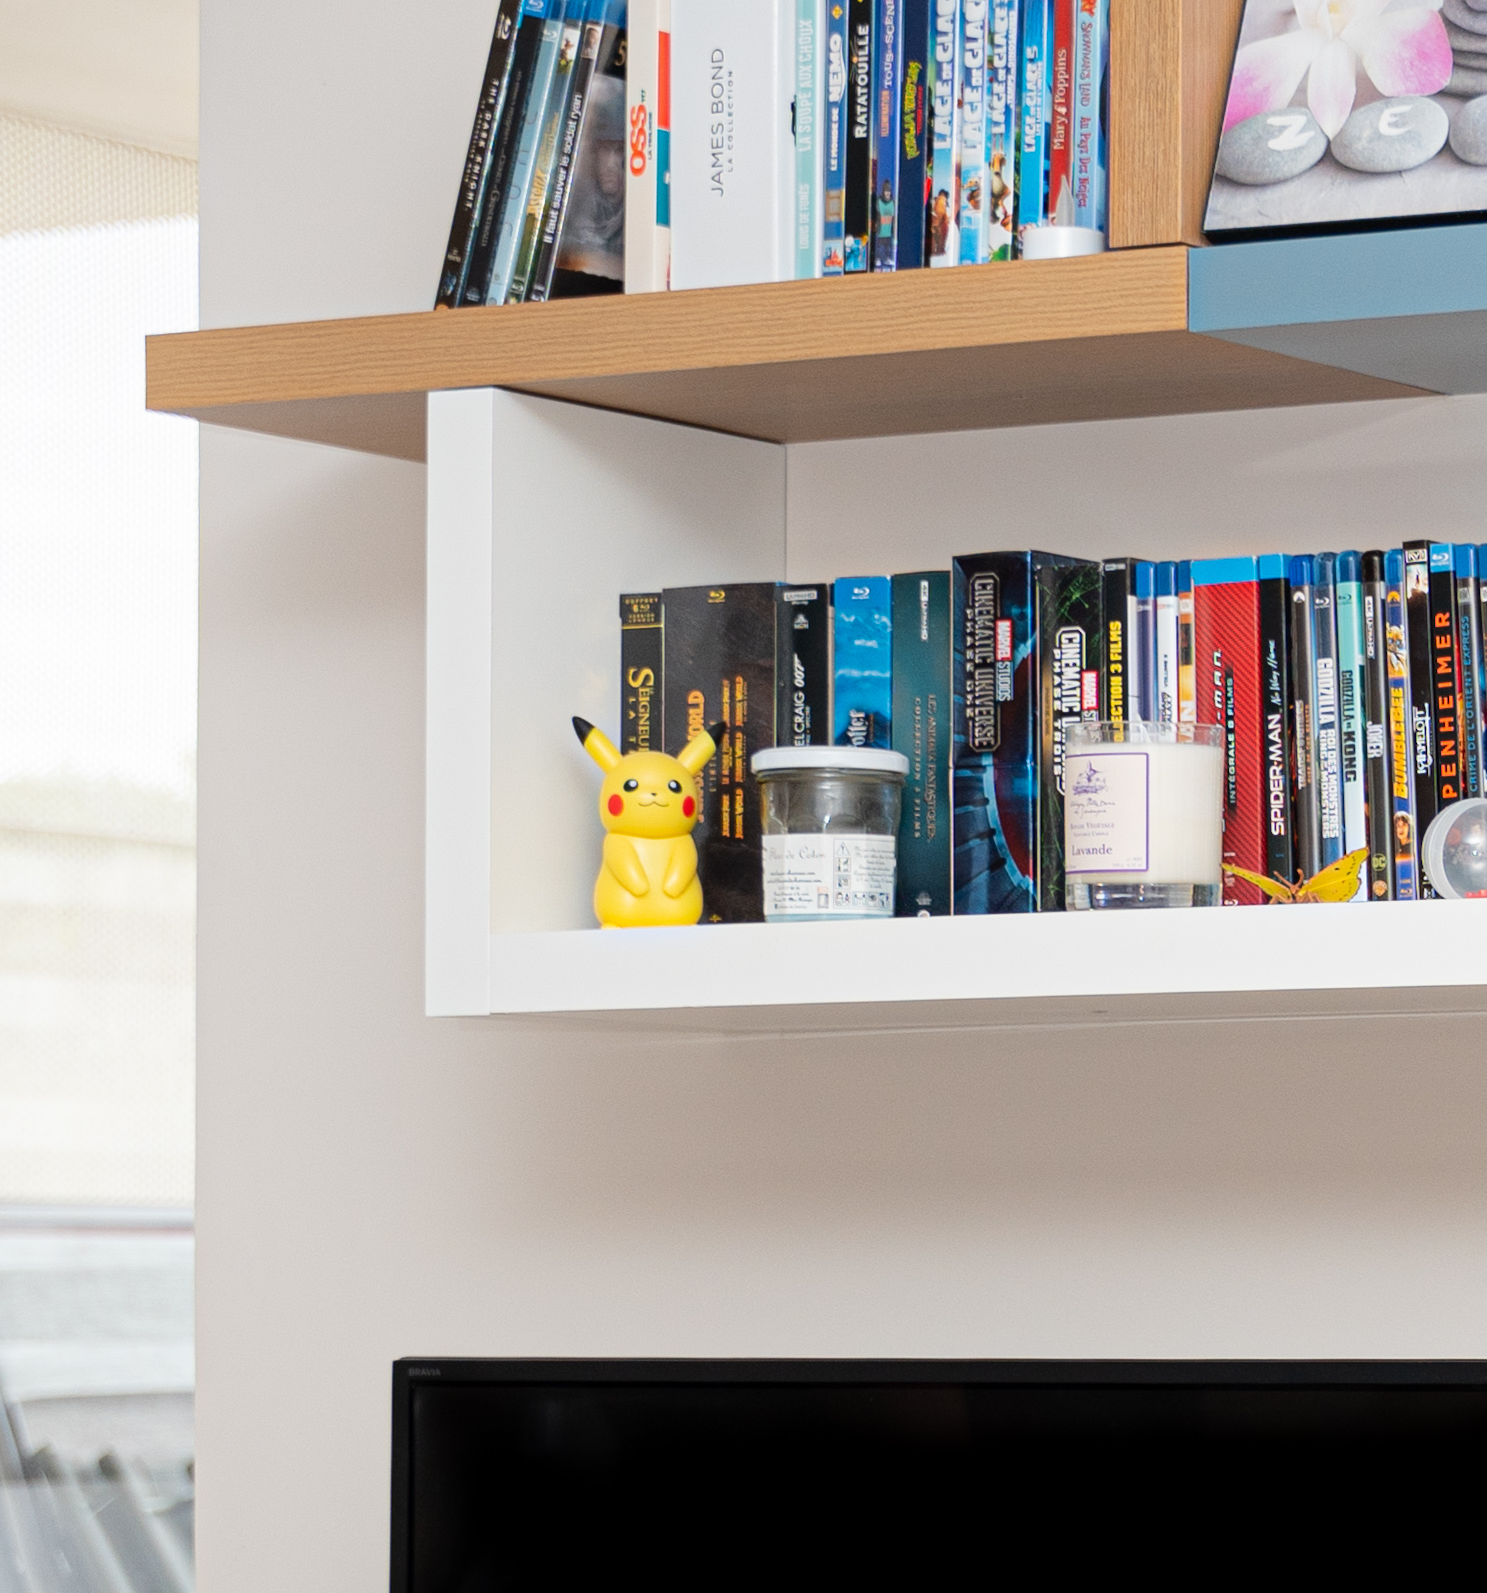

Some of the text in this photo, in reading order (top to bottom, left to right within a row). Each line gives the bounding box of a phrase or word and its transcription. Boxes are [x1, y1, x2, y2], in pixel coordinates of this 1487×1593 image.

[568, 94, 583, 119] ryan
[798, 19, 812, 151] LA SOUPE AUX CHOUX
[828, 33, 843, 171] LE MONDE DE NEMO
[854, 23, 869, 138] RATATOUILLE
[1053, 49, 1069, 150] Mary Poppins
[559, 156, 569, 166] le
[561, 121, 577, 155] soldat
[629, 104, 647, 176] OSS
[710, 48, 725, 197] JAMES BOND
[550, 167, 568, 208] sauver
[727, 159, 734, 173] LA
[546, 210, 560, 235] faut
[965, 608, 974, 719] PHASE ONE
[974, 578, 996, 746] CINEMATIC UNIVERSE
[996, 620, 1013, 702] MARVEL STUDIOS
[1060, 632, 1080, 712] CINEMATIC
[1109, 621, 1122, 673] 3 FILMS
[794, 652, 805, 733] CRAIG 007
[1053, 649, 1062, 776] PHASE TROIS
[1082, 671, 1098, 709] MARVEL
[1317, 658, 1335, 725] GODZILLA
[1342, 670, 1357, 782] GODZILLA KONG
[1461, 615, 1478, 792] CRIME DE L'ORIENT EXPRESS
[1295, 700, 1307, 790] TRANSFORMERS
[1366, 720, 1383, 758] JOKER
[1390, 688, 1408, 799] BUMBLEBEE
[1071, 843, 1113, 857] Lavande
